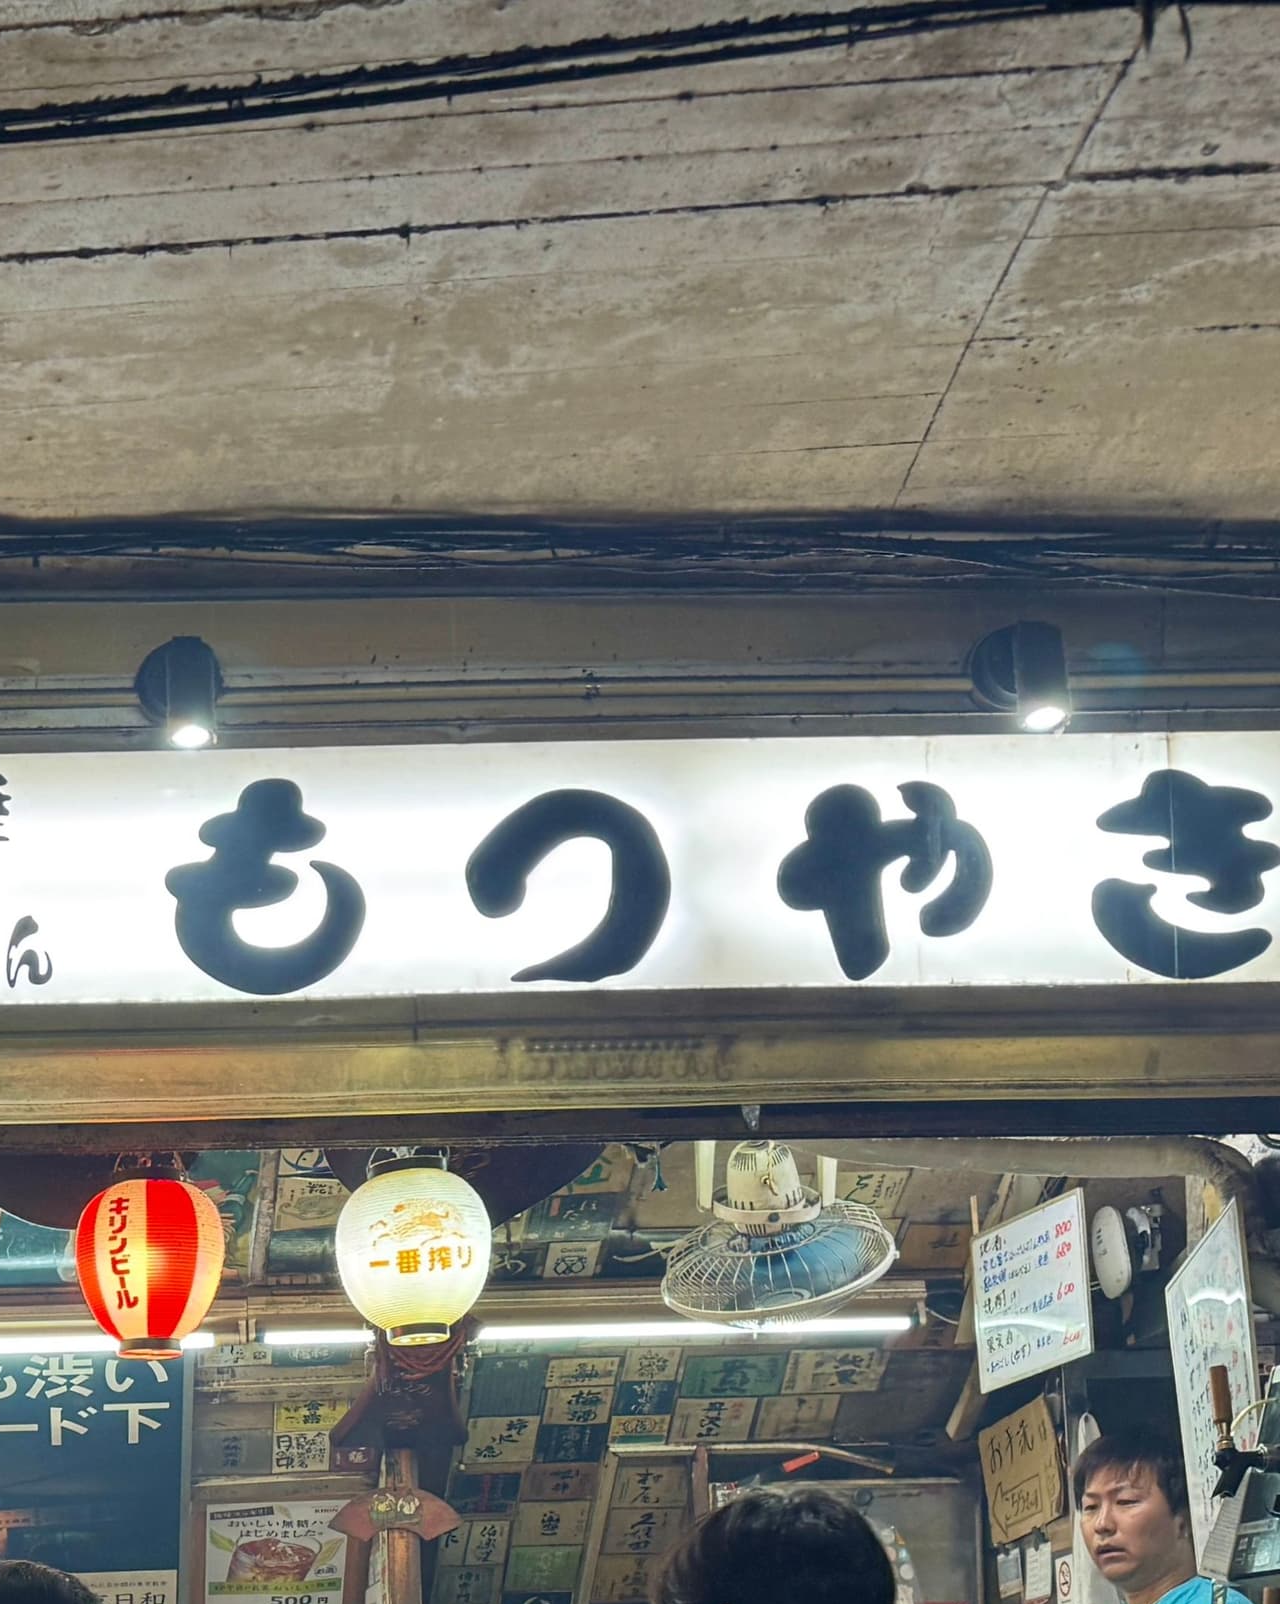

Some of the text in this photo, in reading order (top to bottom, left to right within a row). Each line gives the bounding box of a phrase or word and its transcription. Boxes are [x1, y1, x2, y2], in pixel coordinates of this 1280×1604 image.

[165, 769, 1280, 996] もつやき
[107, 1196, 139, 1310] キリンビール
[369, 1248, 473, 1275] 一番搾り
[228, 1518, 326, 1531] おいしい無糖ハ
